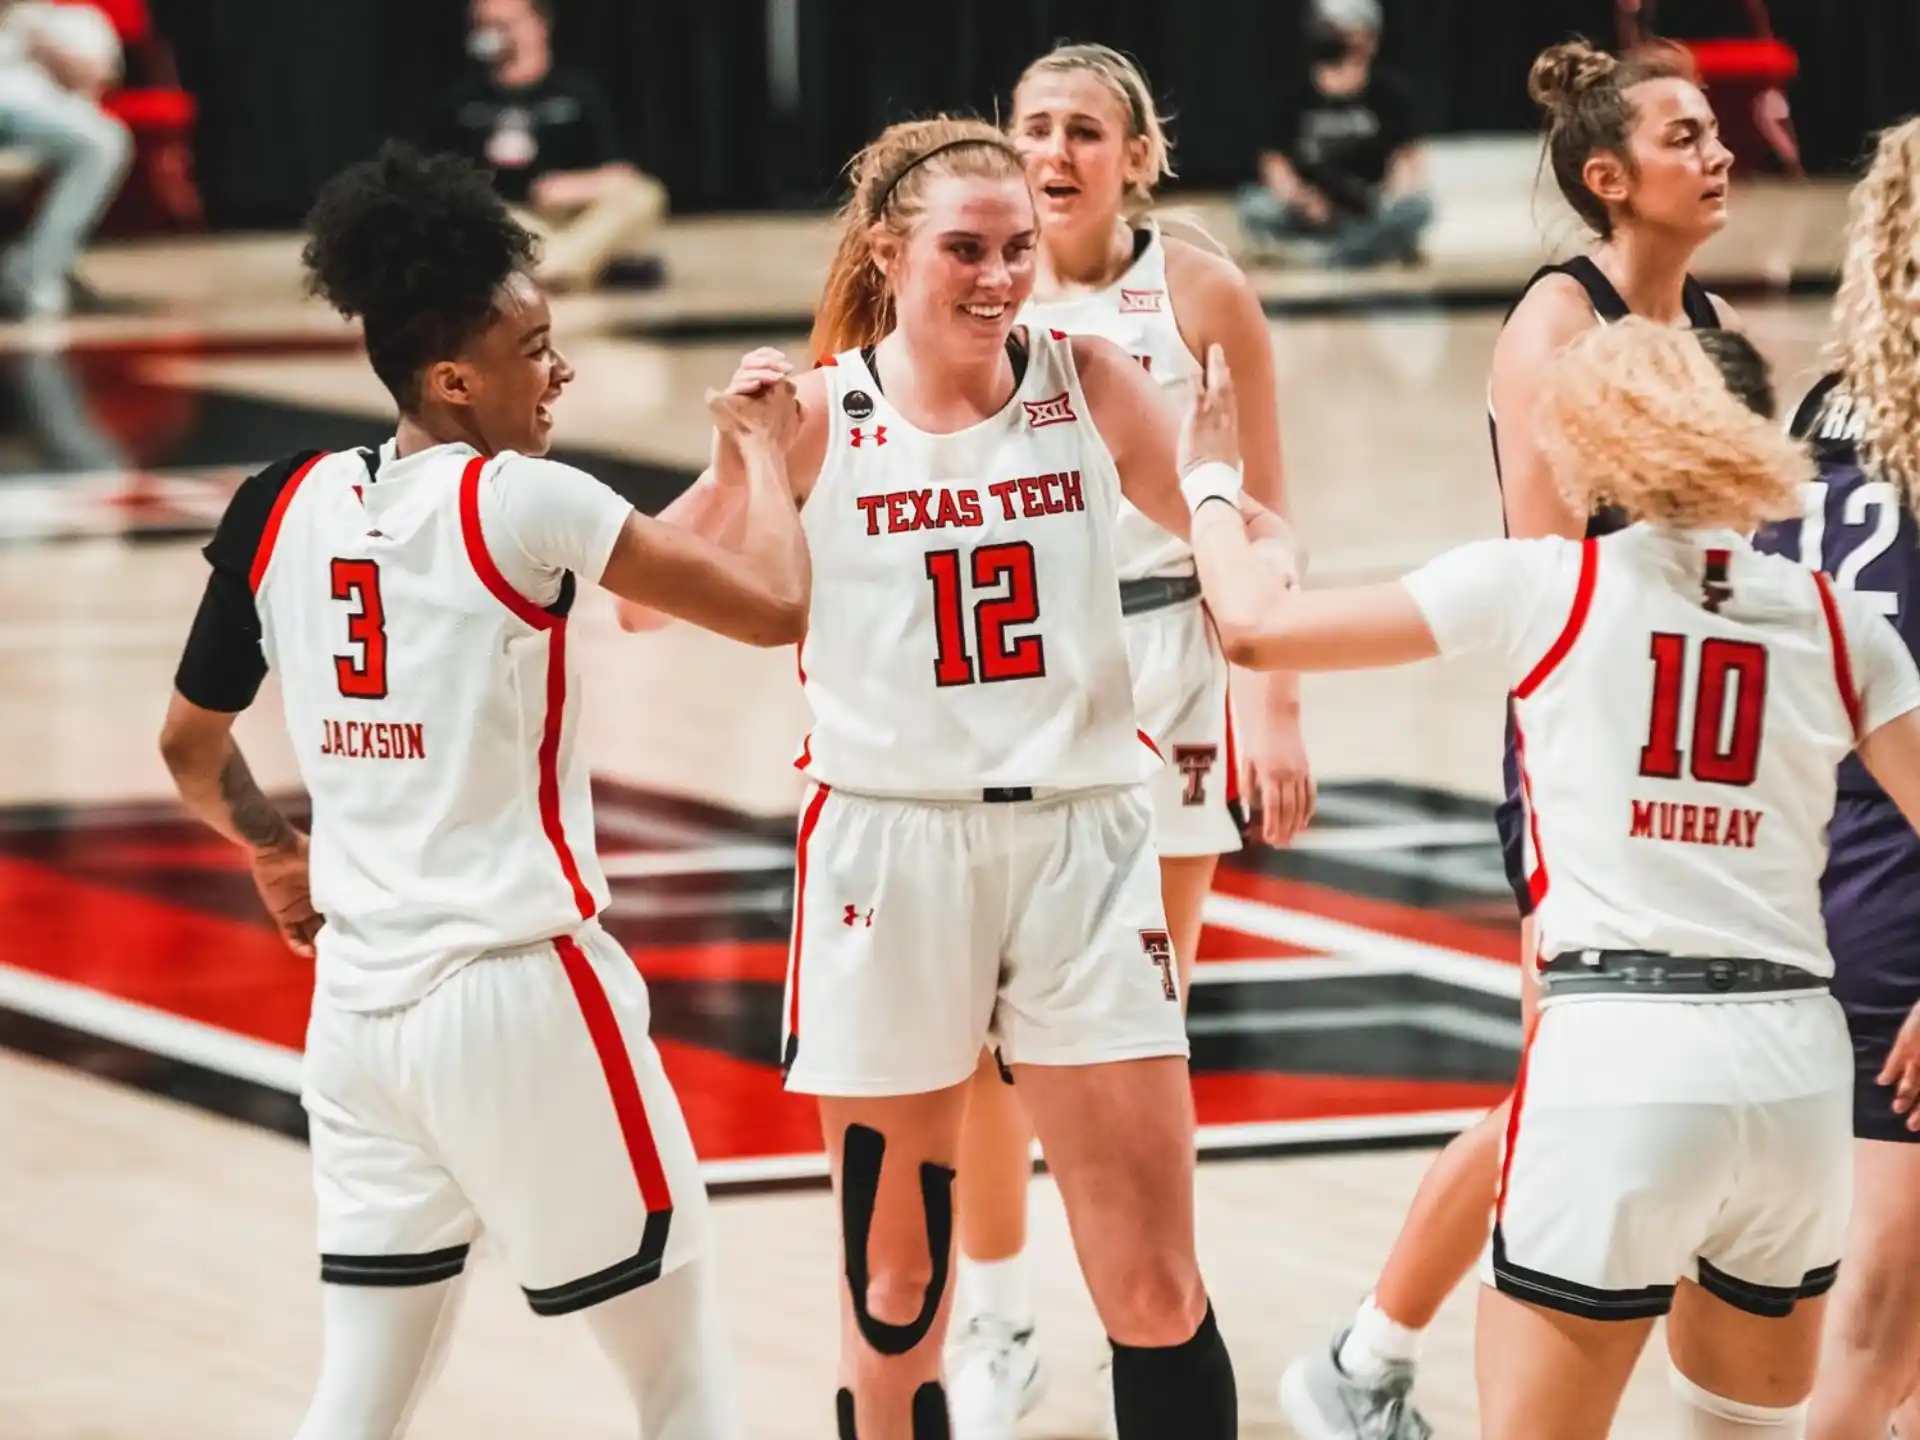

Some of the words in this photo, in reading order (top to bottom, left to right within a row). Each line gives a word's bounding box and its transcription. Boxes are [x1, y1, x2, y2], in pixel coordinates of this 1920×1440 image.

[857, 489, 983, 536] TEXAS
[989, 471, 1085, 521] TECH
[1800, 481, 1899, 615] 12
[330, 557, 389, 700] 3
[924, 540, 1046, 688] 12
[321, 719, 426, 760] JACKSON
[1638, 631, 1769, 787] 10
[1629, 800, 1763, 848] MURRAY
